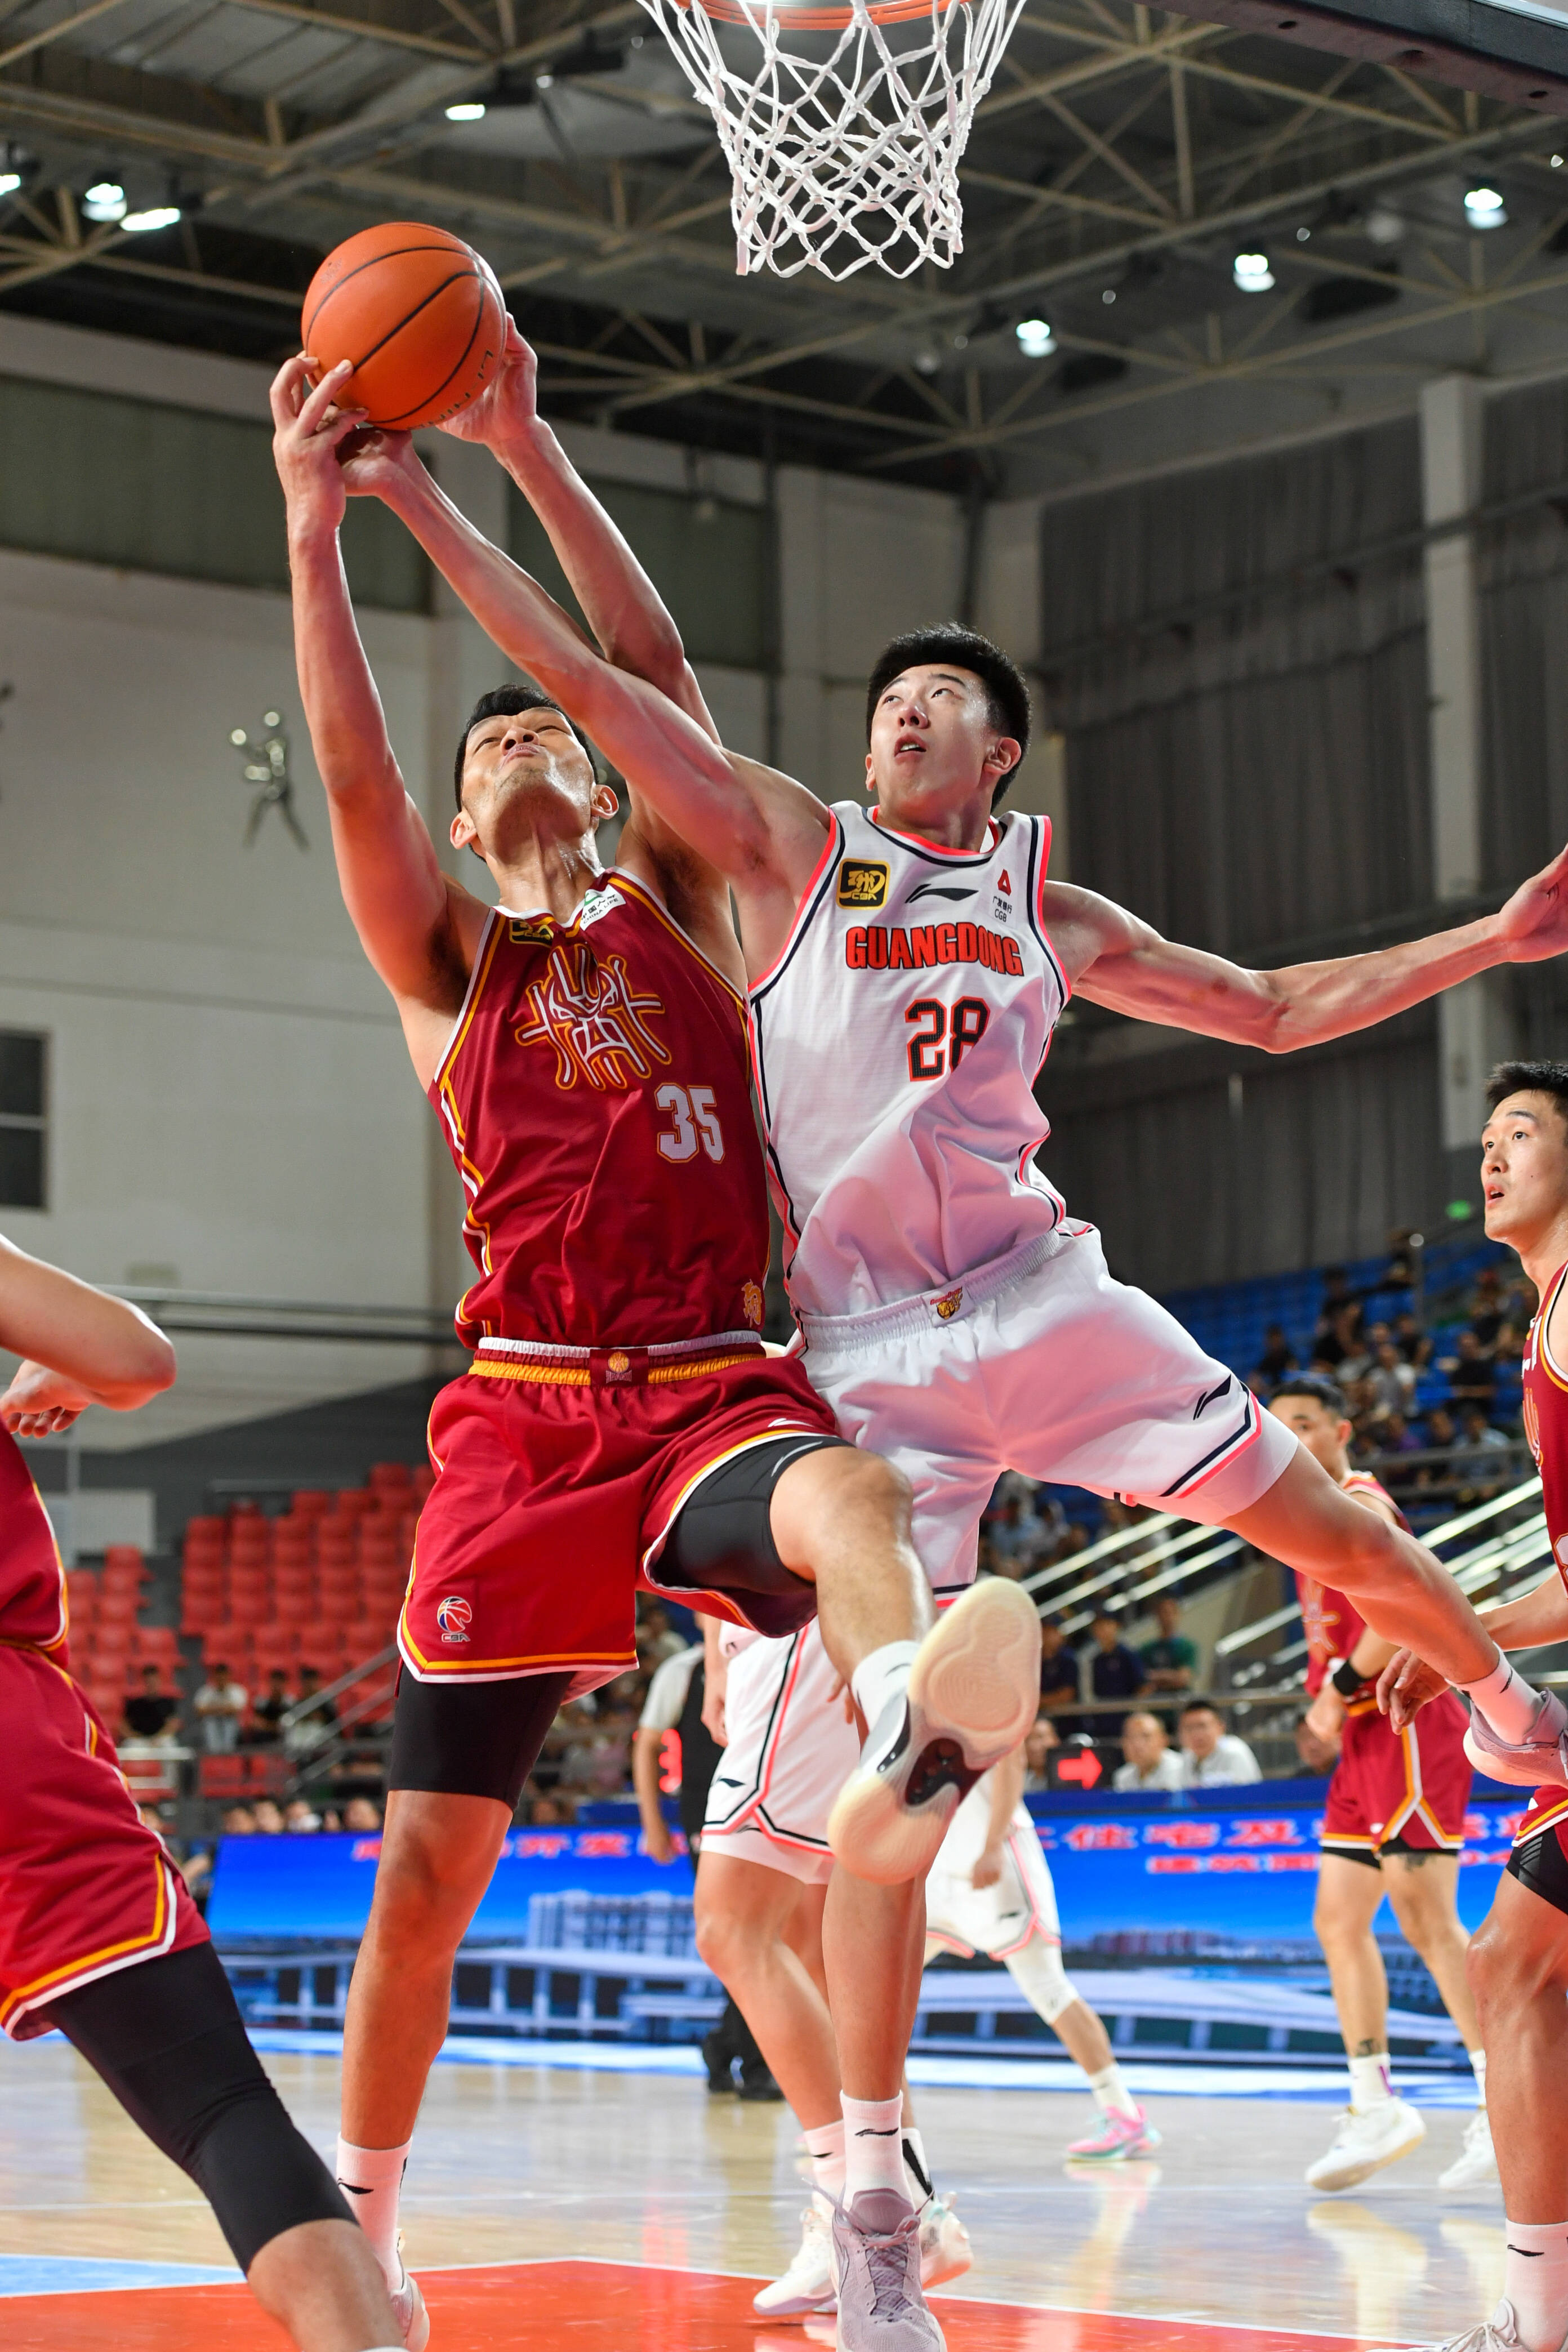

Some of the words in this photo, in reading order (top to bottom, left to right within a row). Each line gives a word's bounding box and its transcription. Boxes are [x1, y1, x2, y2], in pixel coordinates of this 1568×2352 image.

[992, 896, 1013, 914] 广发银行
[583, 908, 603, 924] CHINA
[994, 908, 1007, 922] CGB
[845, 921, 1025, 977] GUANGDONG
[904, 995, 991, 1082] 28
[654, 1082, 726, 1164] 35
[441, 1632, 471, 1643] CBA
